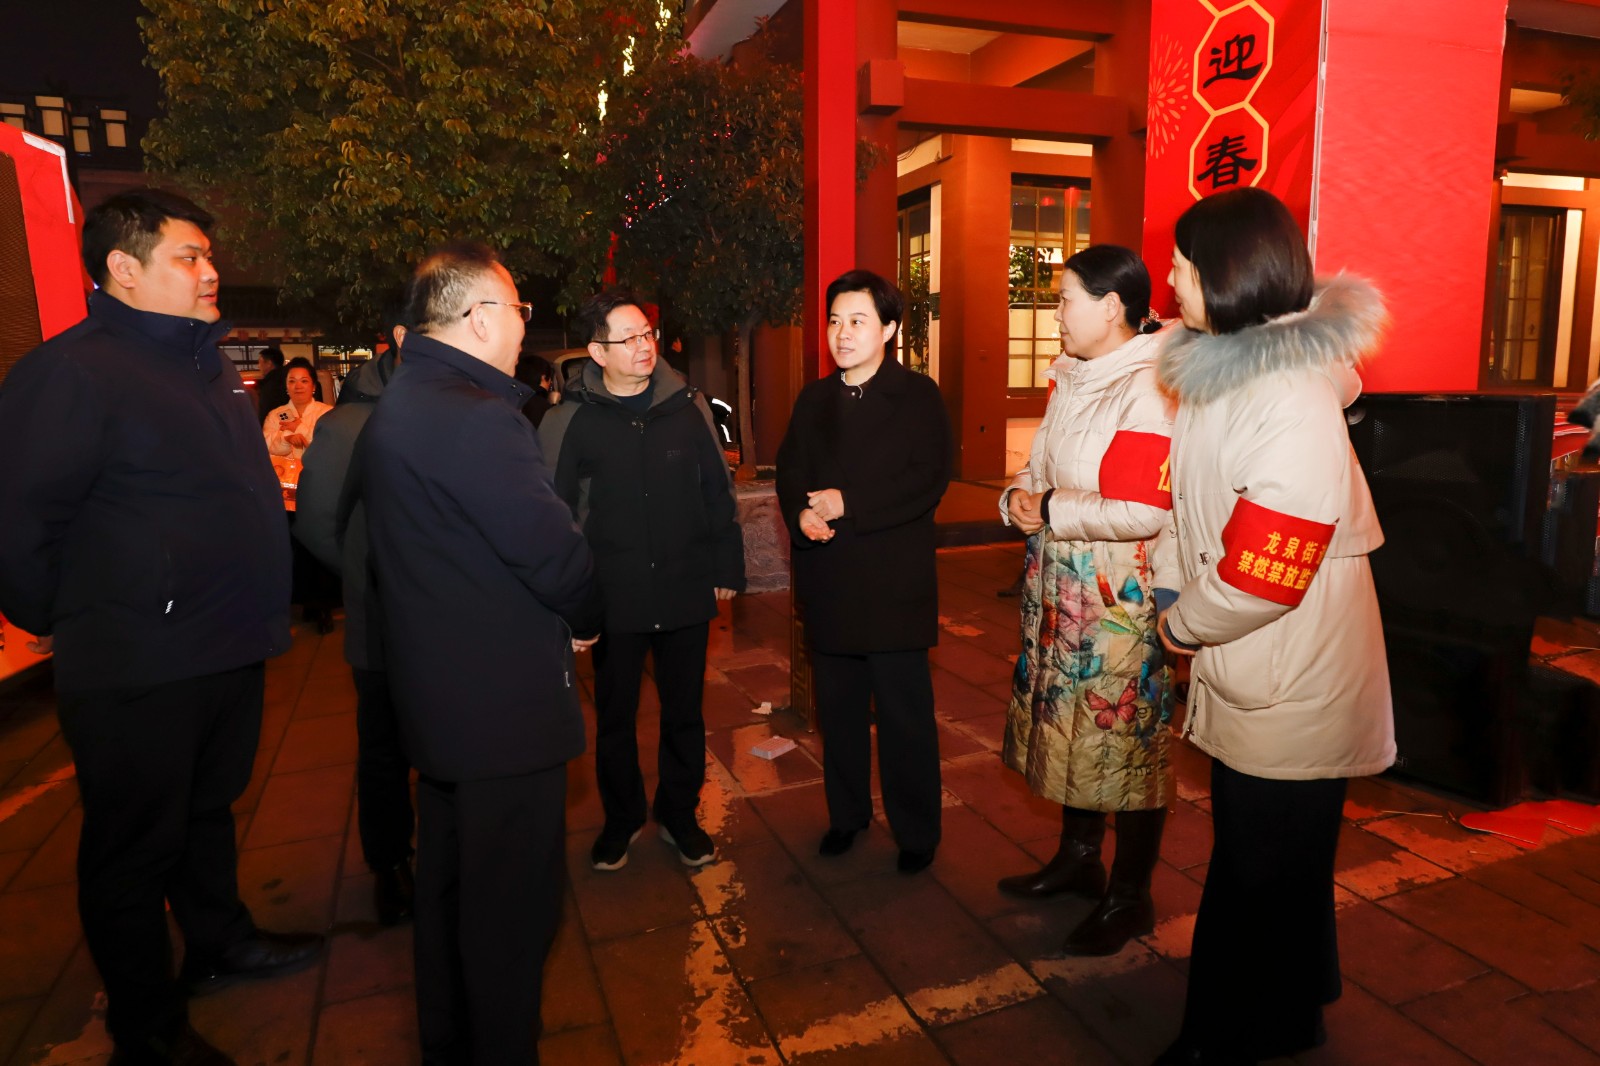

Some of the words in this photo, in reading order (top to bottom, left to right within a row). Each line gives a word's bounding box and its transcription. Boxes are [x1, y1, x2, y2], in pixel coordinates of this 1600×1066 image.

[1197, 34, 1264, 189] 迎春
[1237, 550, 1315, 590] 禁燃禁放监
